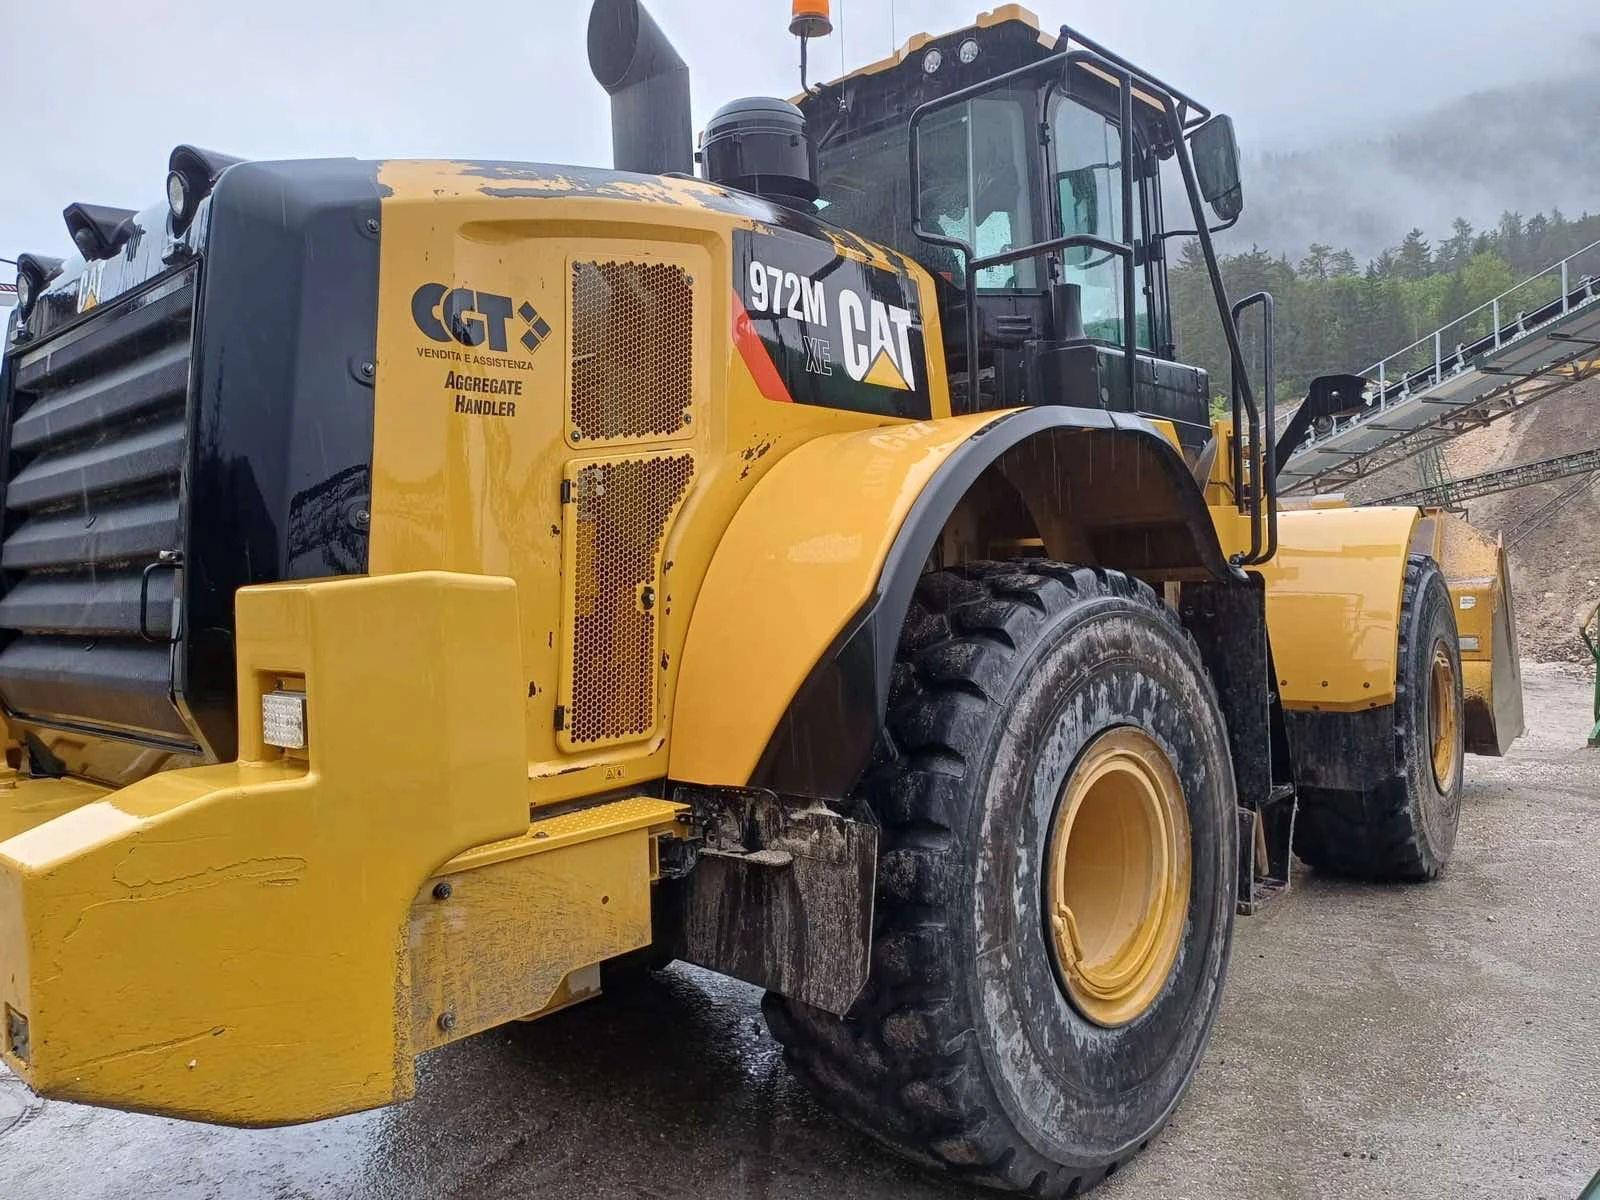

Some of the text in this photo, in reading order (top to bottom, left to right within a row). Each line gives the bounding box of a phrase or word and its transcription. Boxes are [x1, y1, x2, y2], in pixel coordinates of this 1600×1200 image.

[77, 260, 106, 314] CAT
[750, 260, 828, 328] 972M
[411, 282, 514, 352] CGT
[838, 289, 916, 392] CAT
[416, 347, 534, 371] VENDITA E ASSISTENZA
[803, 335, 833, 377] XE
[444, 370, 523, 396] AGGREGATE
[455, 394, 516, 417] HANDLER
